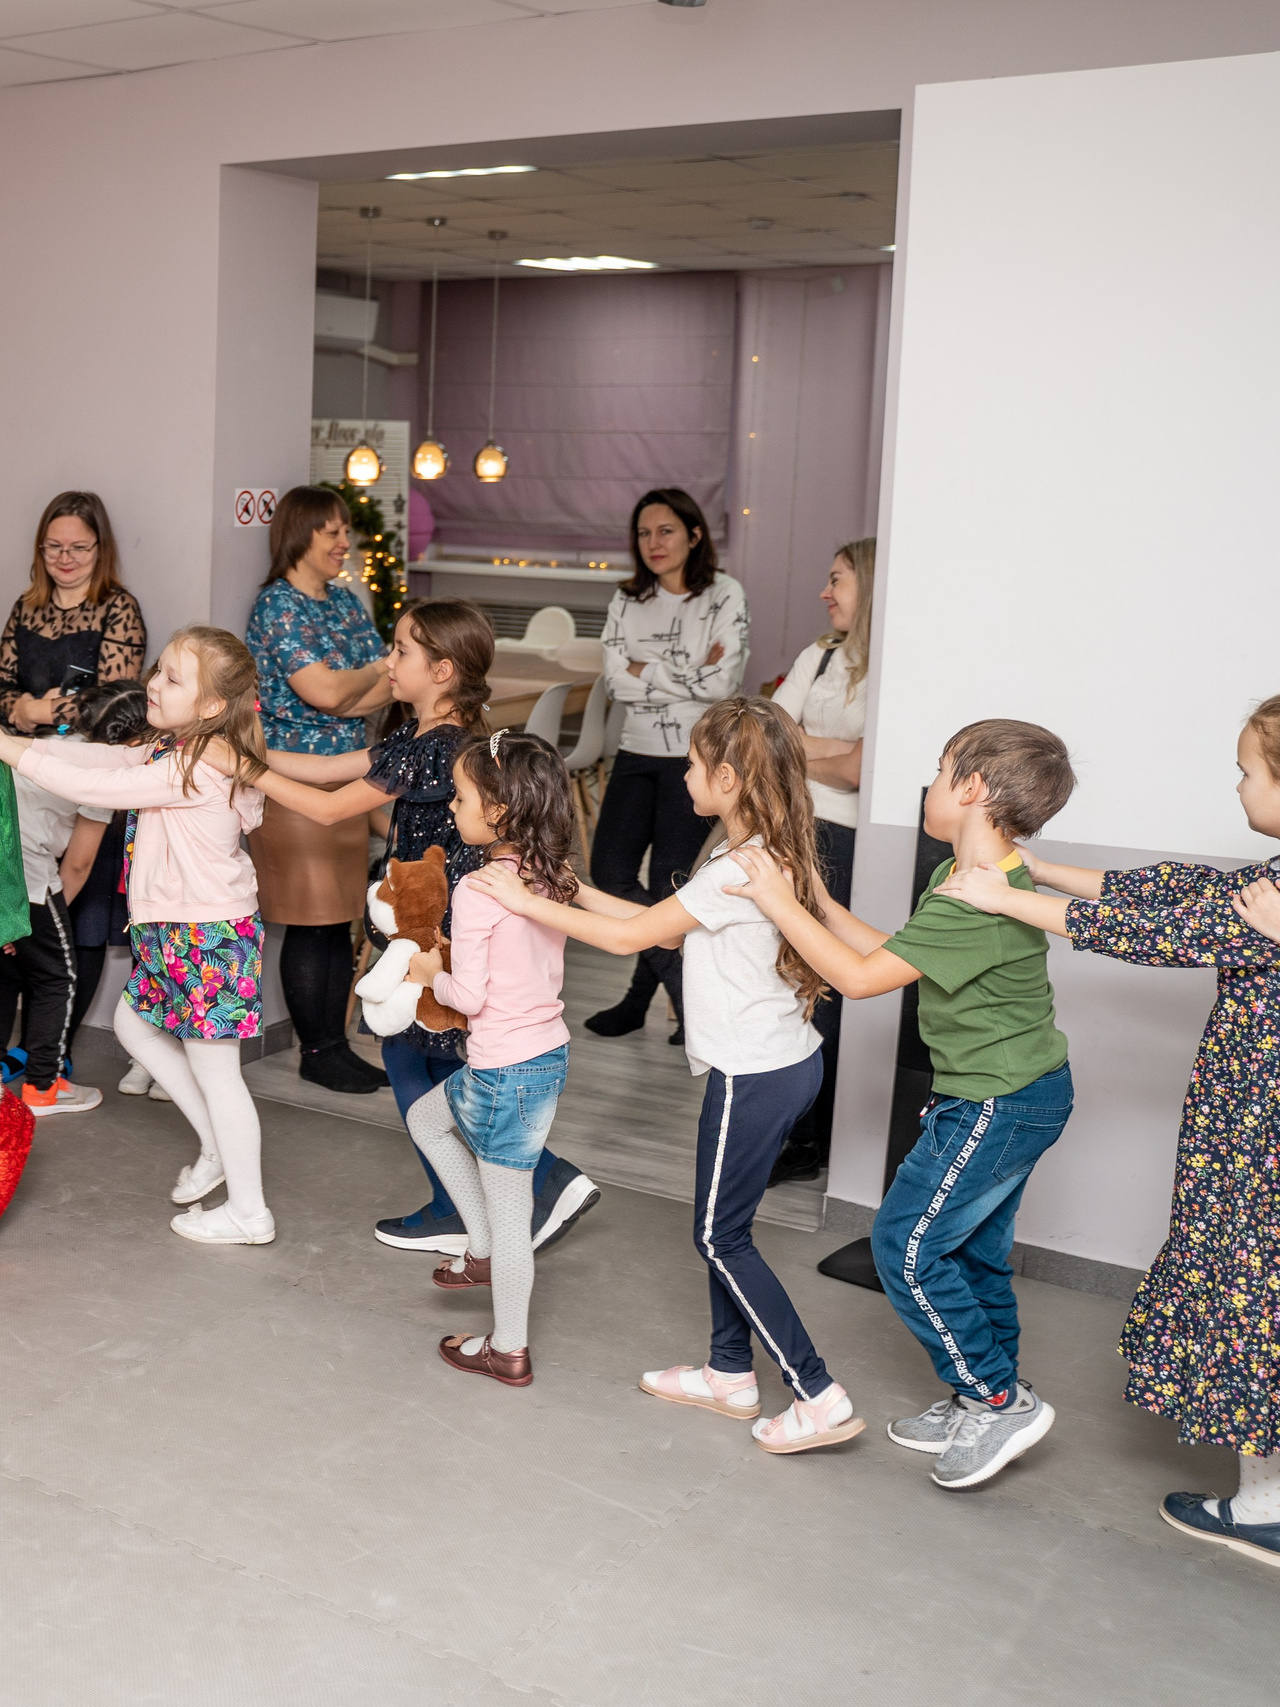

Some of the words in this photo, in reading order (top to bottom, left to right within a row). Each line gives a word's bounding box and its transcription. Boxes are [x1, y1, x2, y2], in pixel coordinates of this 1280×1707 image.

[971, 1113, 991, 1139] FIRST
[953, 1136, 979, 1169] LEAGUE
[940, 1165, 960, 1191] FIRST
[925, 1189, 949, 1218] LEAGUE
[911, 1215, 931, 1239] FIRST
[904, 1236, 920, 1269] LEAGUE
[911, 1285, 935, 1313] LEAGUE
[927, 1312, 948, 1333] FIRST
